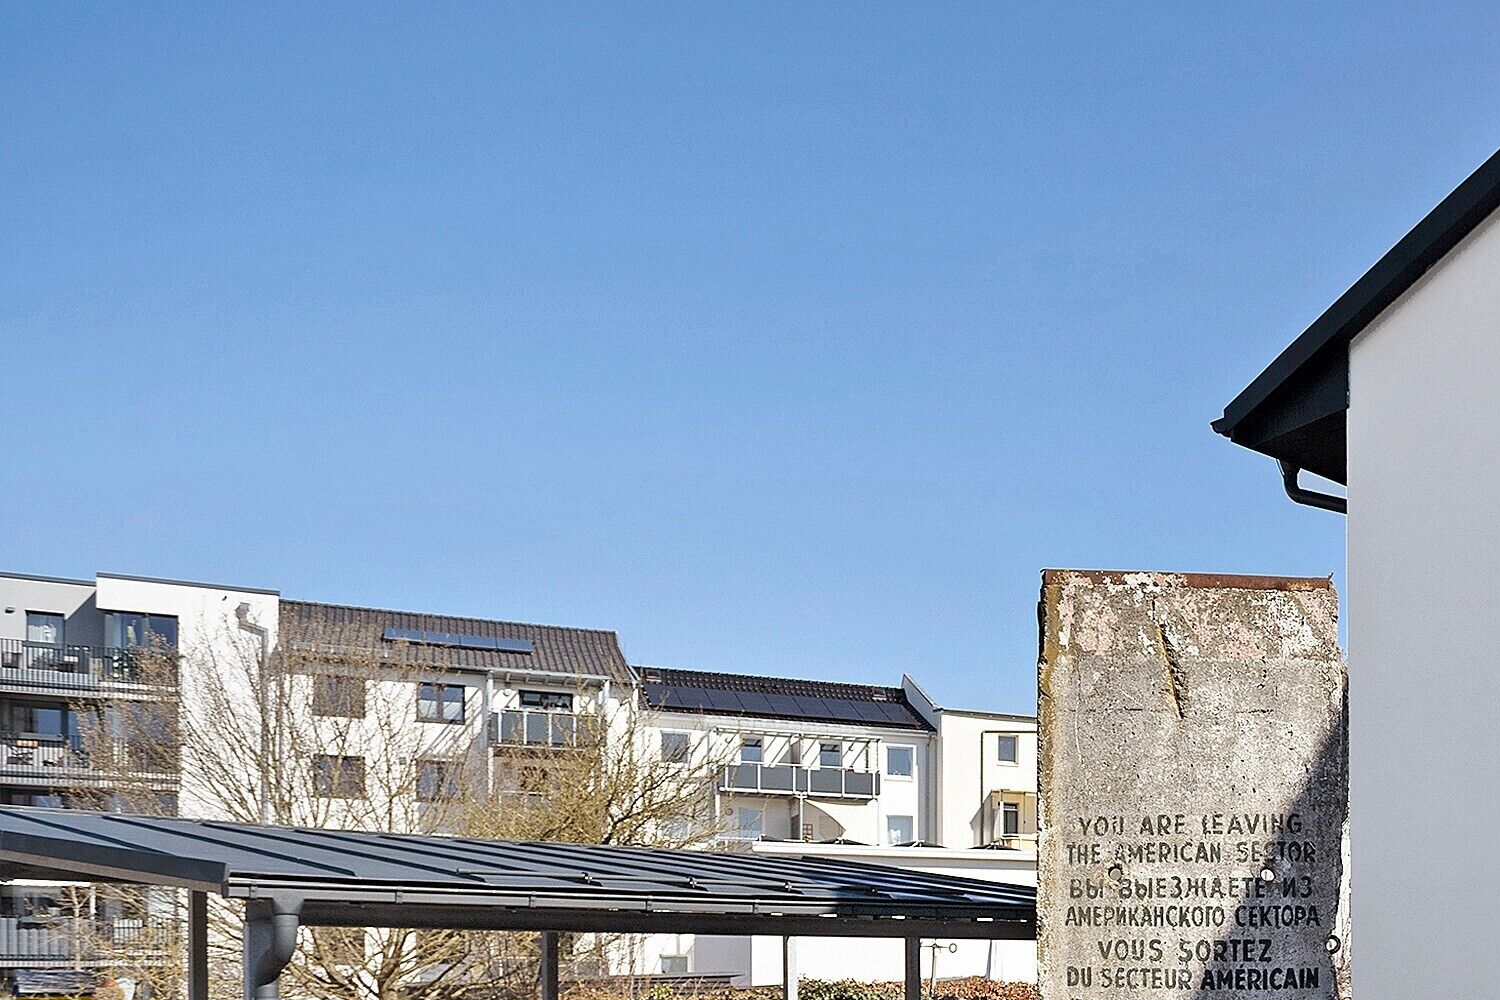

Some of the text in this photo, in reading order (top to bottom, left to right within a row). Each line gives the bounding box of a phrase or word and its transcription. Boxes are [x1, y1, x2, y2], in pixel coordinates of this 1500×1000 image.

[1079, 812, 1302, 836] YOU ARE LEAVING
[1066, 841, 1316, 865] THE AMERICAN SECTOR
[1069, 878, 1104, 899] ВЫ
[1282, 876, 1313, 898] ИЗ
[1234, 904, 1321, 928] СЕКТОРА
[1098, 938, 1272, 962] VOUS SORTEZ
[1066, 966, 1092, 987] DU
[1100, 967, 1193, 990] SECTEUR
